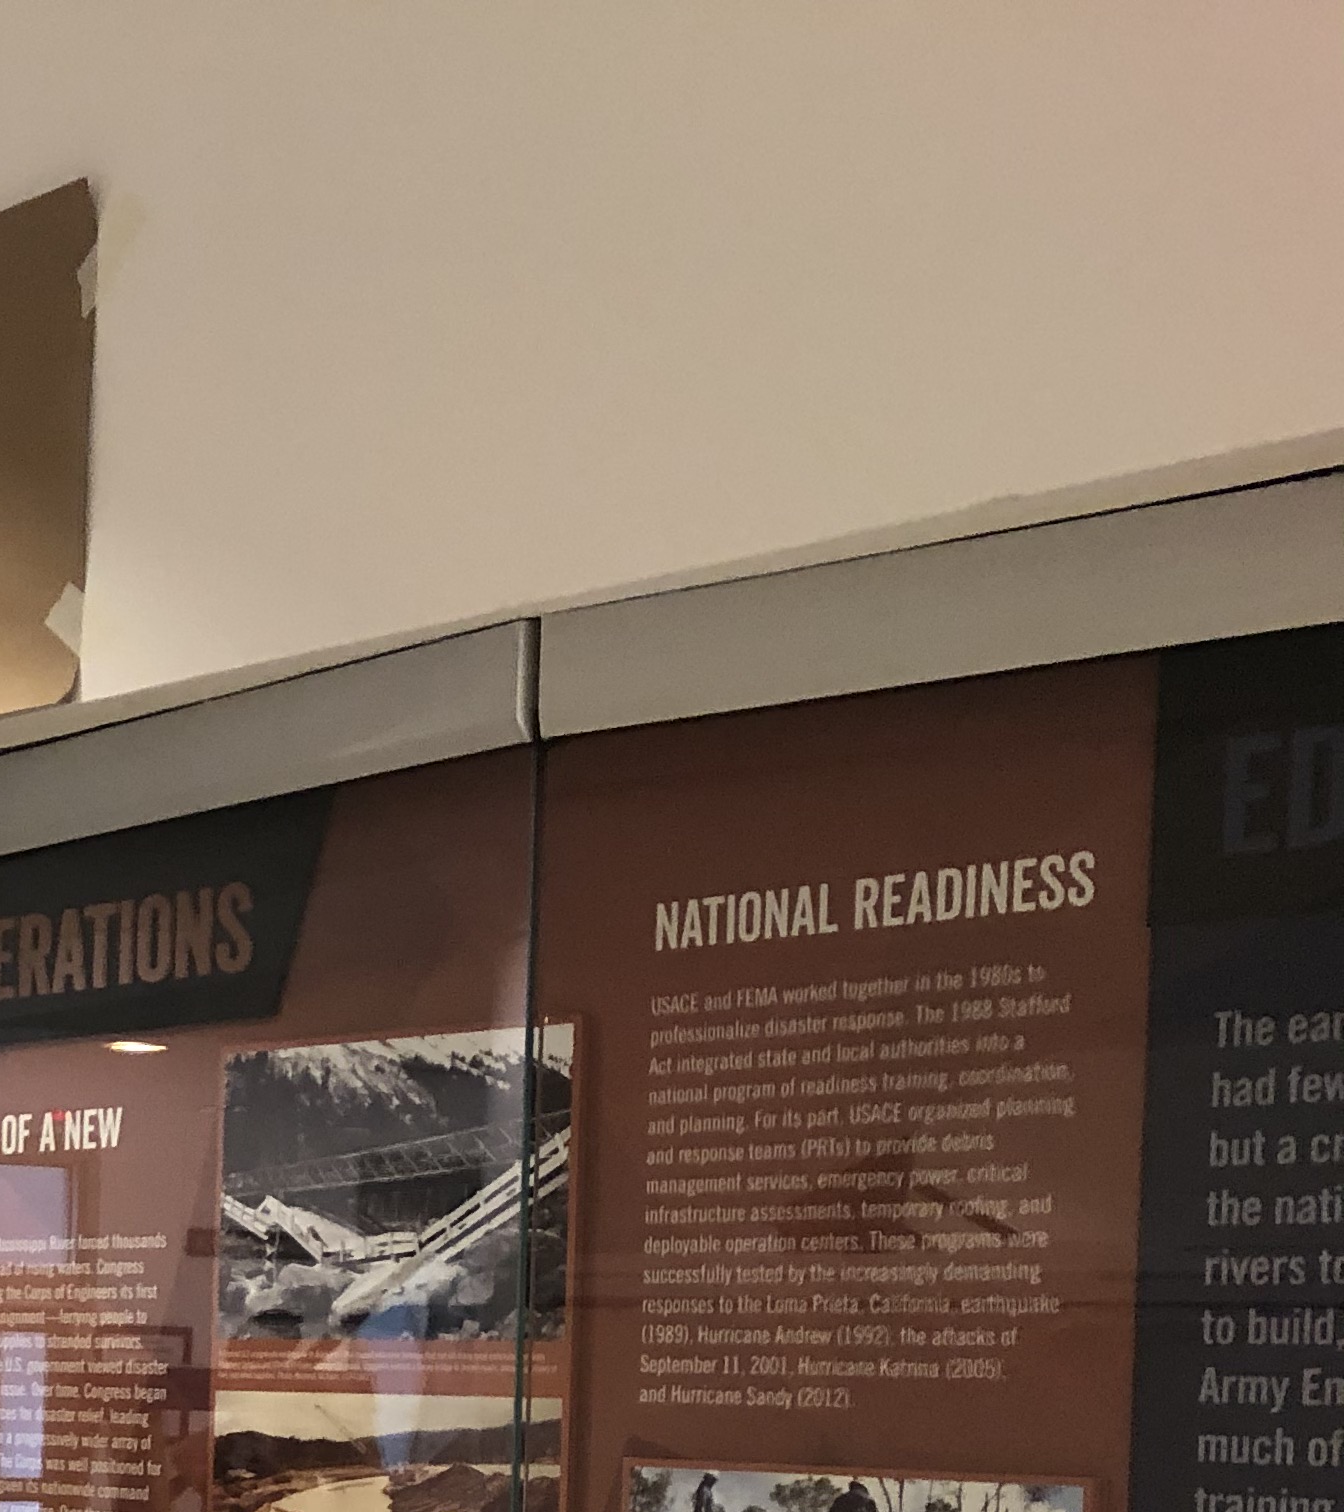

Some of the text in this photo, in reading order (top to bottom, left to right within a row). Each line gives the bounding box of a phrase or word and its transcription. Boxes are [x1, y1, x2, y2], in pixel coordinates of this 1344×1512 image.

[654, 849, 1097, 952] NATIONAL READINESS
[651, 967, 1021, 1013] USACE and FEMA worked 1980s
[650, 1001, 993, 1047] professionalize disaster The 1988
[1214, 1010, 1275, 1049] The
[648, 1043, 874, 1074] Act state and local
[648, 1077, 876, 1104] national program of readiness
[1211, 1067, 1276, 1108] had
[1, 1113, 32, 1155] OF
[38, 1112, 56, 1152] A
[64, 1107, 123, 1151] NEW
[849, 1106, 901, 1125] USACE
[678, 1141, 850, 1166] response teams (PRTs)
[1209, 1129, 1266, 1168] but
[1276, 1134, 1297, 1165] a
[646, 1175, 741, 1197] management
[816, 1173, 904, 1191] emergency
[644, 1206, 745, 1224] infrastructure
[1207, 1189, 1261, 1227] the
[644, 1234, 915, 1257] deployable operation These
[642, 1266, 783, 1286] successfully tested
[1203, 1249, 1306, 1286] rivers
[642, 1296, 806, 1316] responses Loma
[697, 1326, 770, 1343] Hurricane
[775, 1327, 832, 1343] Andrew
[1201, 1309, 1236, 1345] to
[640, 1357, 716, 1377] September
[83, 1383, 130, 1401] Congress
[670, 1387, 792, 1410] Hurricane Sandy
[1198, 1366, 1289, 1413] Army
[1197, 1427, 1294, 1466] much
